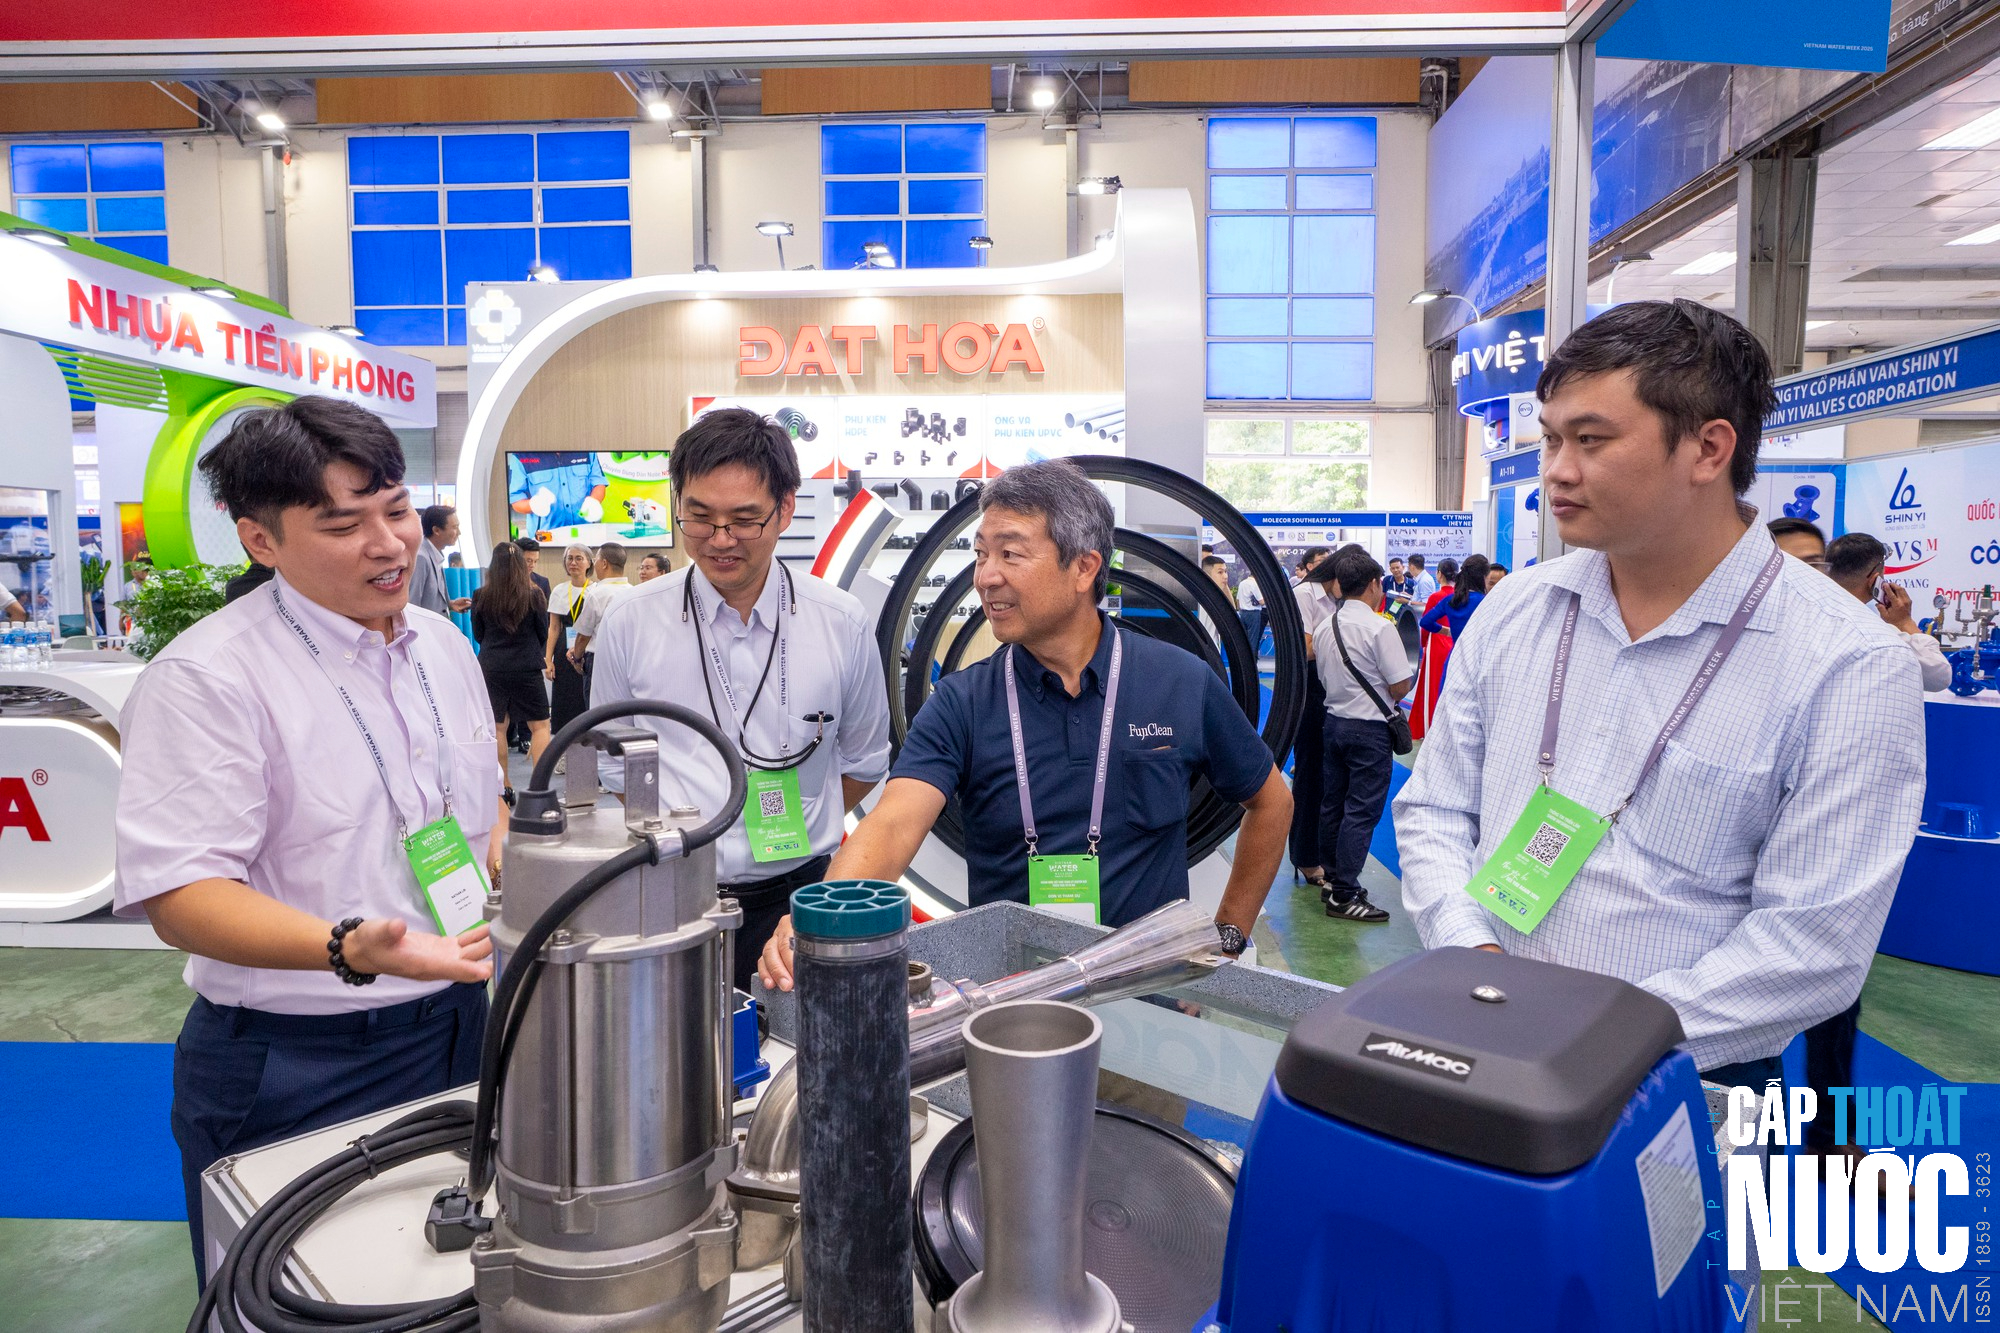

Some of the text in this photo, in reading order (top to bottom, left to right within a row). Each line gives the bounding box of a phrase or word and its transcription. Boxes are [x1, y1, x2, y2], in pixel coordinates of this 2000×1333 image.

[67, 278, 416, 403] NHỰA TIỀN PHONG
[1472, 330, 1545, 374] VIỆT
[1775, 346, 1959, 404] NG TY CỔ PHẦN VAN SHIN YI
[1787, 405, 1798, 423] YI
[1800, 394, 1845, 419] VALVES
[1847, 371, 1957, 410] CORPORATION
[845, 428, 868, 436] HDPE
[1037, 429, 1063, 437] UPVC
[1885, 512, 1926, 523] SHIN YI
[1967, 498, 1995, 521] QUỐC
[1893, 538, 1938, 561] VS M
[1741, 576, 1770, 614] VIETNAM
[1905, 578, 1930, 589] YANG
[294, 623, 320, 656] VIETNAM
[710, 647, 720, 665] WEEK
[1551, 610, 1575, 702] VIETNAM WATER WEEK
[339, 685, 353, 707] WEEK
[724, 685, 738, 712] VIETNAM
[1657, 650, 1724, 745] VIETNAM WATER WEEK
[432, 705, 445, 738] VIETNAM
[365, 732, 384, 768] VIETNAM
[1013, 731, 1022, 753] WATER
[1097, 706, 1113, 783] VIETNAM WATER WEEK
[1016, 753, 1026, 786] VIETNAM
[1049, 864, 1078, 872] WATER
